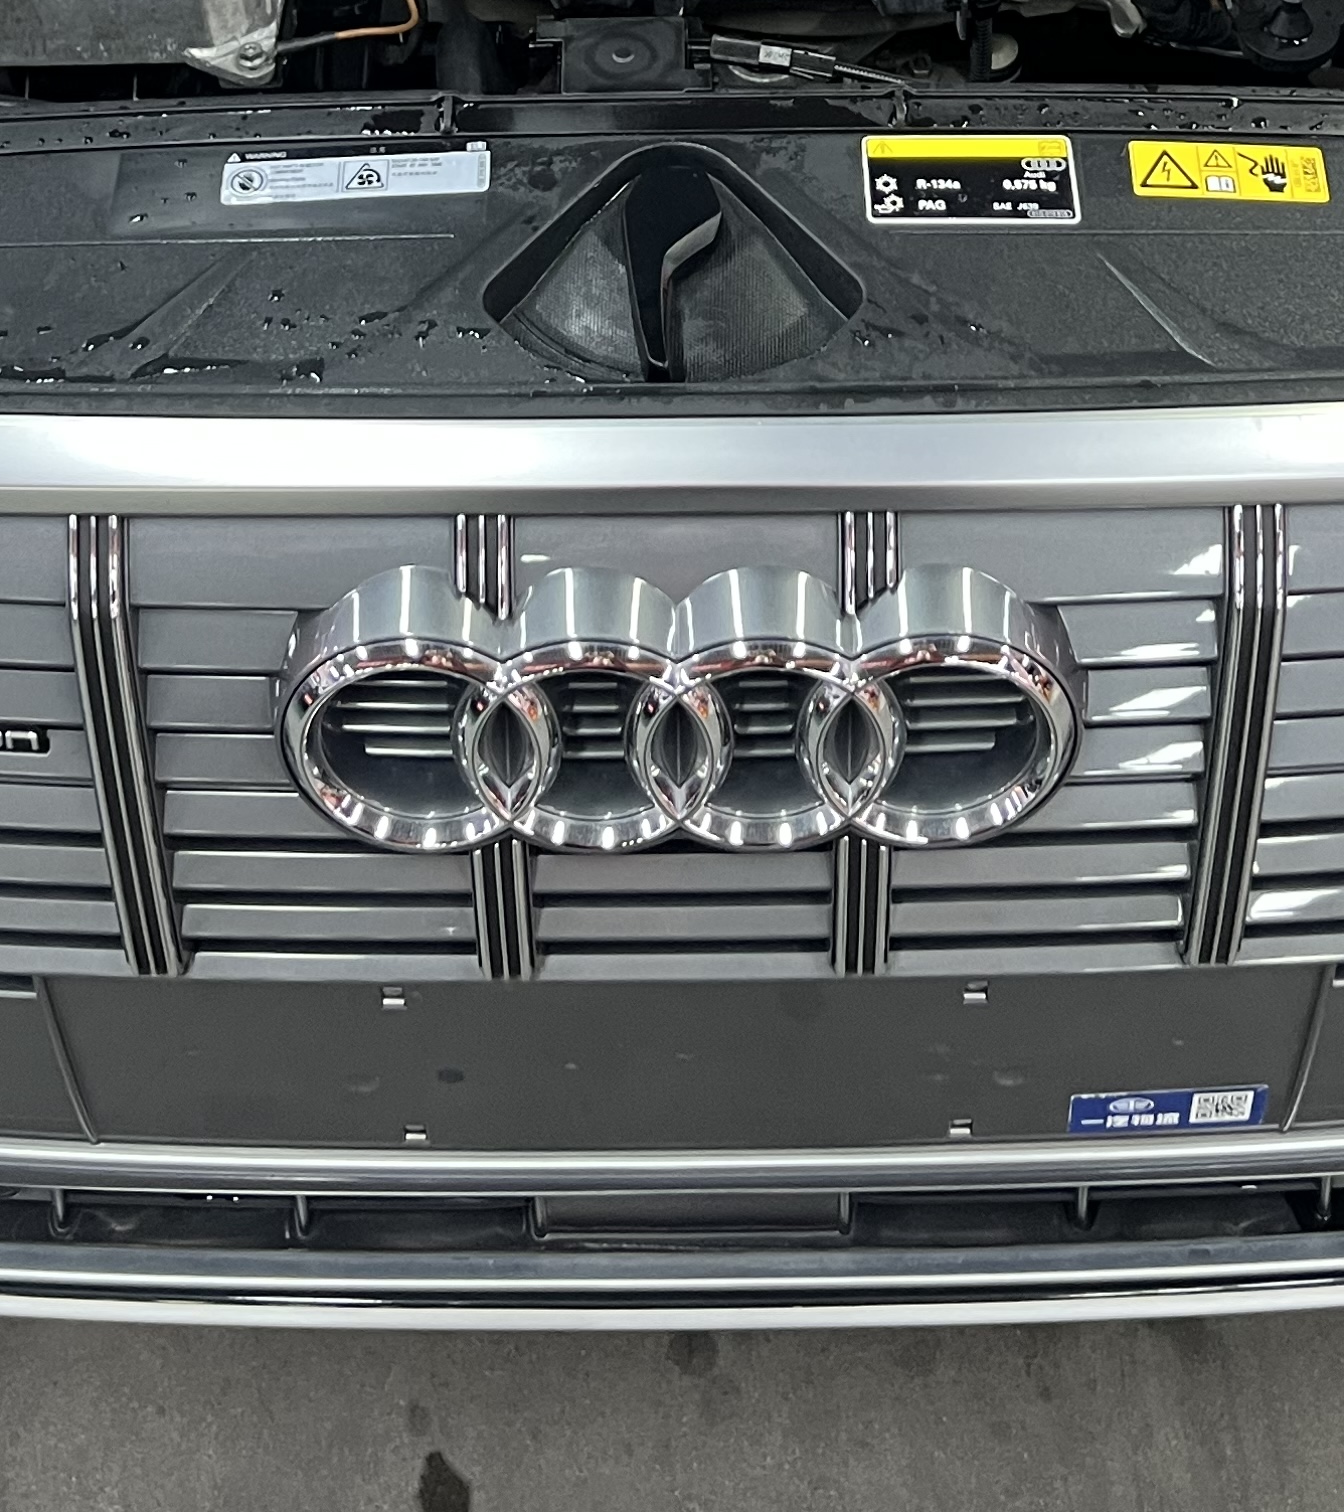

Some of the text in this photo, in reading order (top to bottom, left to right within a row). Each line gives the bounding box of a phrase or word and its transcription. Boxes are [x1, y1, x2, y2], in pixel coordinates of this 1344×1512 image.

[244, 151, 288, 161] WARNING
[1023, 170, 1047, 179] Audi
[916, 178, 961, 190] R-134a
[1038, 178, 1057, 192] kg
[917, 199, 947, 211] PAG
[992, 201, 1013, 211] SAE
